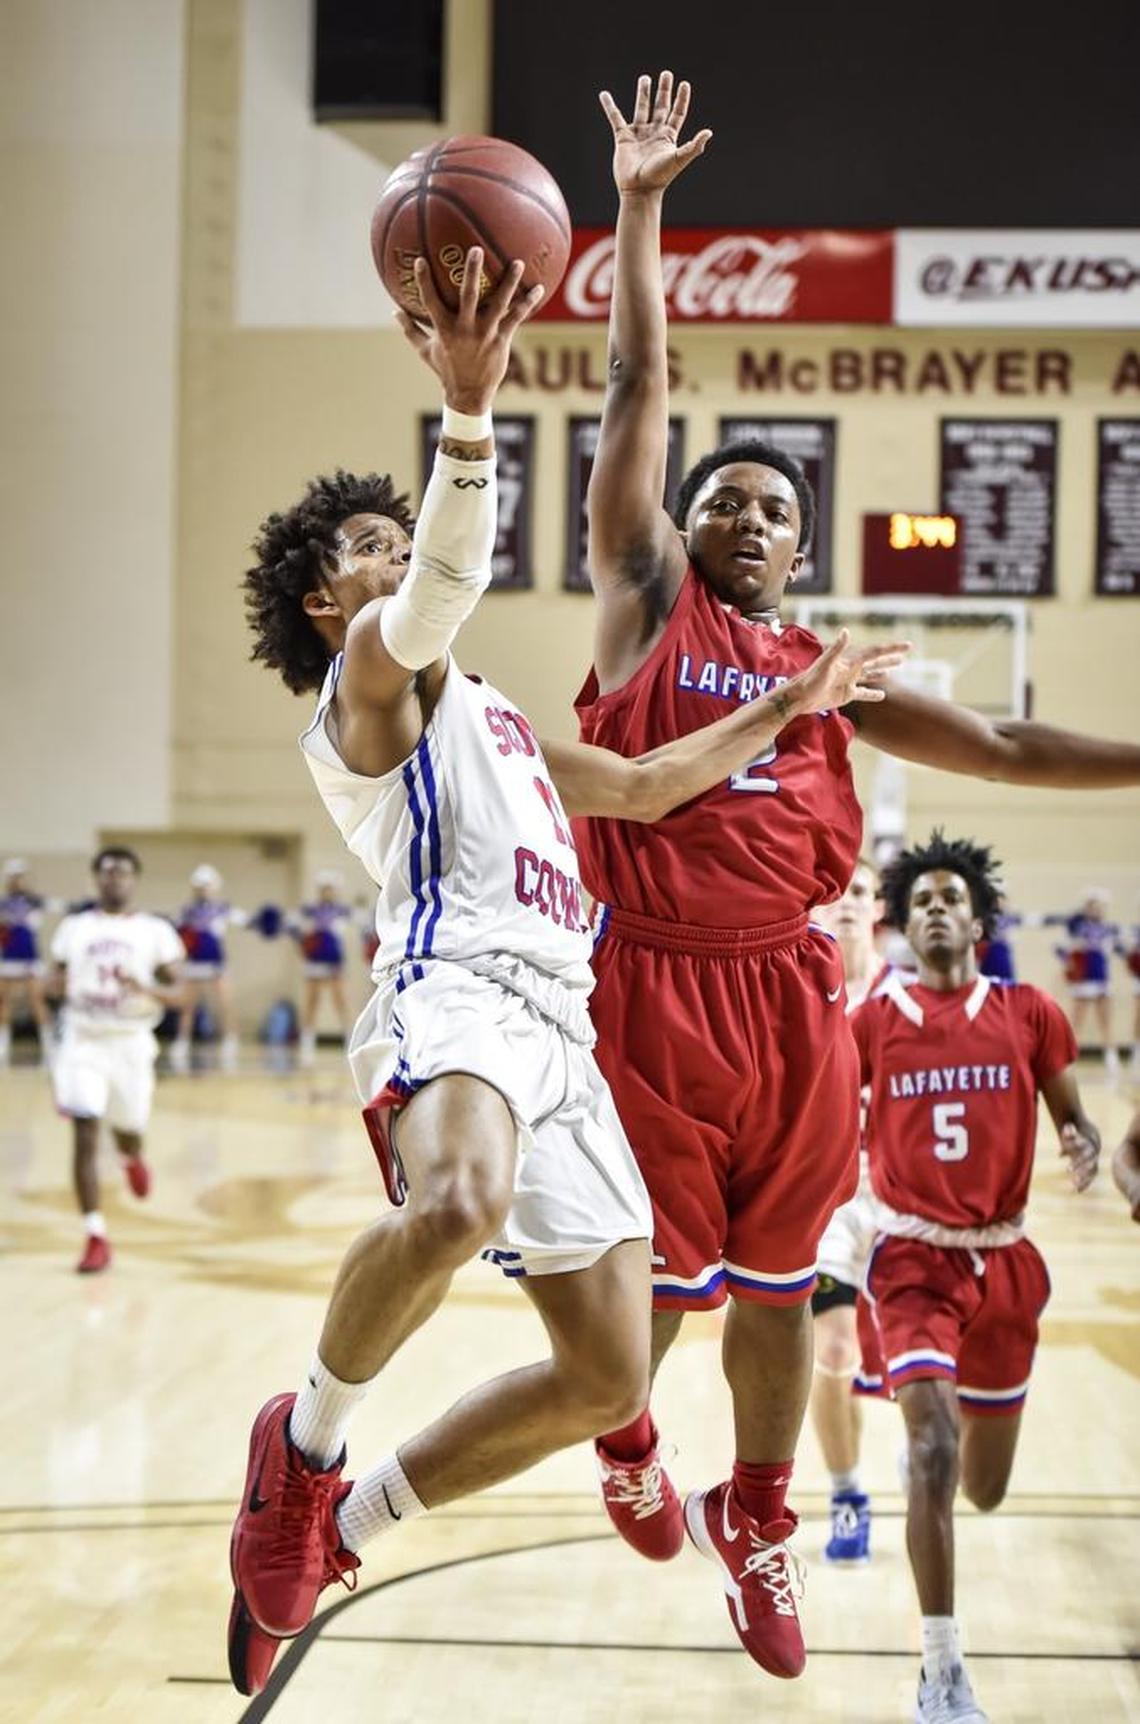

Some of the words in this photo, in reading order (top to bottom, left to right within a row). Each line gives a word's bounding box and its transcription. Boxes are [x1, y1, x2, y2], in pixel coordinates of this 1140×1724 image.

[738, 349, 1074, 393] McBRAYER
[889, 1064, 1011, 1099] LAFAYETTE
[931, 1101, 970, 1163] 5
